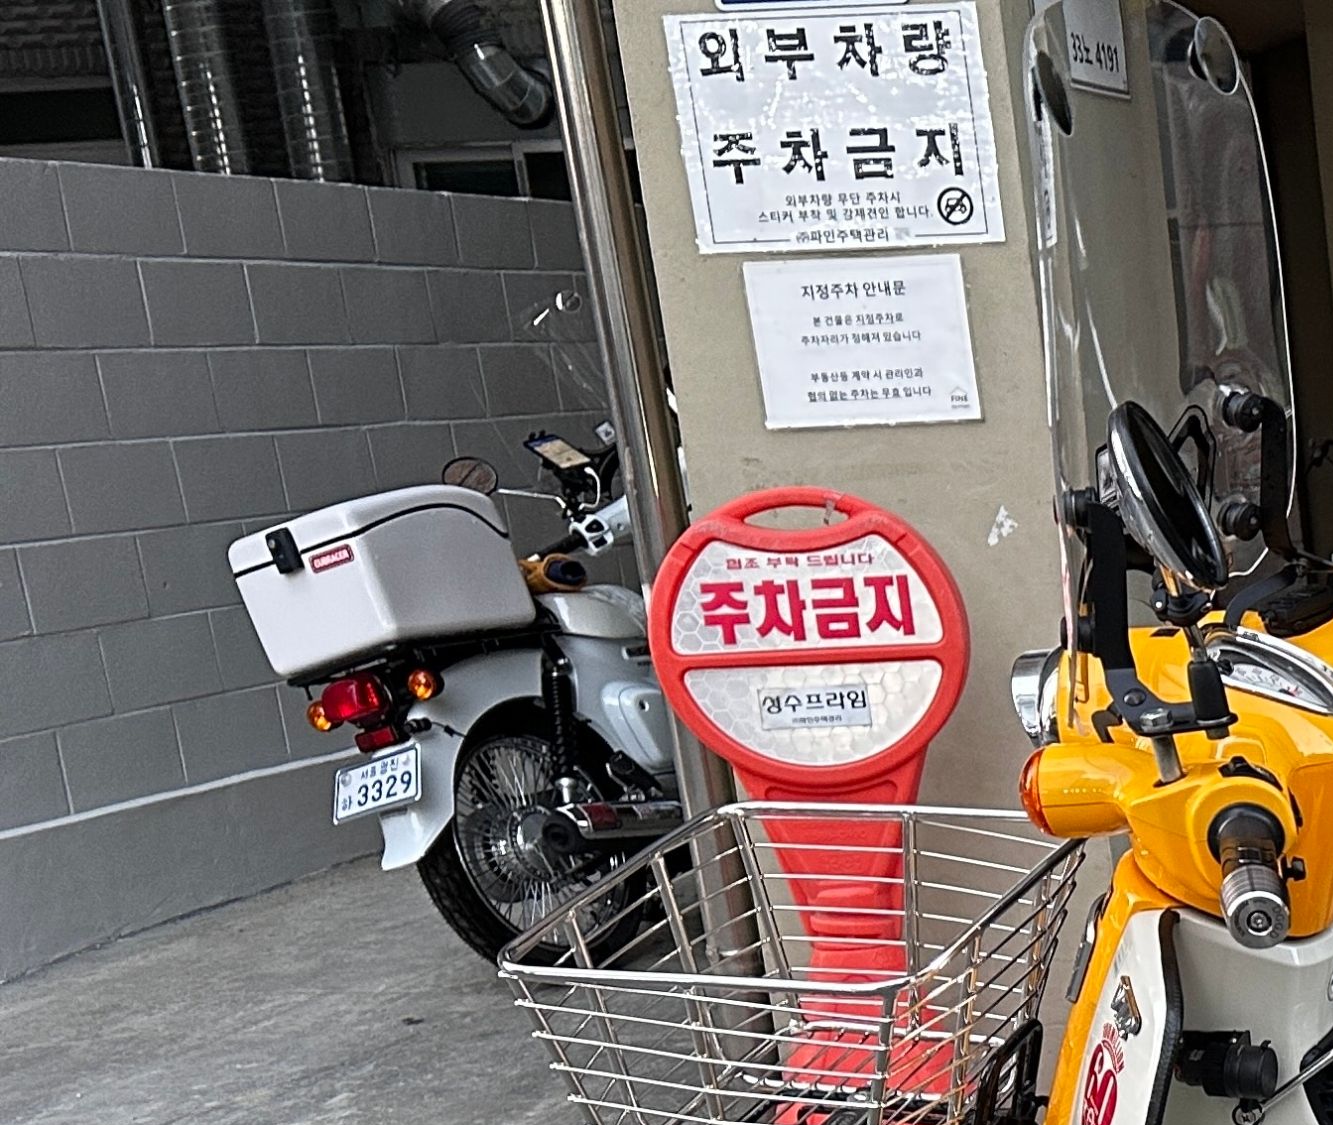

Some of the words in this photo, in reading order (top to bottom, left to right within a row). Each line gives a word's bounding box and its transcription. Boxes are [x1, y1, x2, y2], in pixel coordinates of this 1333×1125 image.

[698, 20, 952, 82] 외부차량
[1071, 32, 1093, 65] 33노
[1096, 42, 1119, 73] 4191
[713, 123, 965, 184] 주차금지
[801, 282, 858, 301] 지정주차
[862, 280, 906, 298] 안내문
[700, 574, 916, 646] 주차금지
[357, 770, 412, 806] 3329
